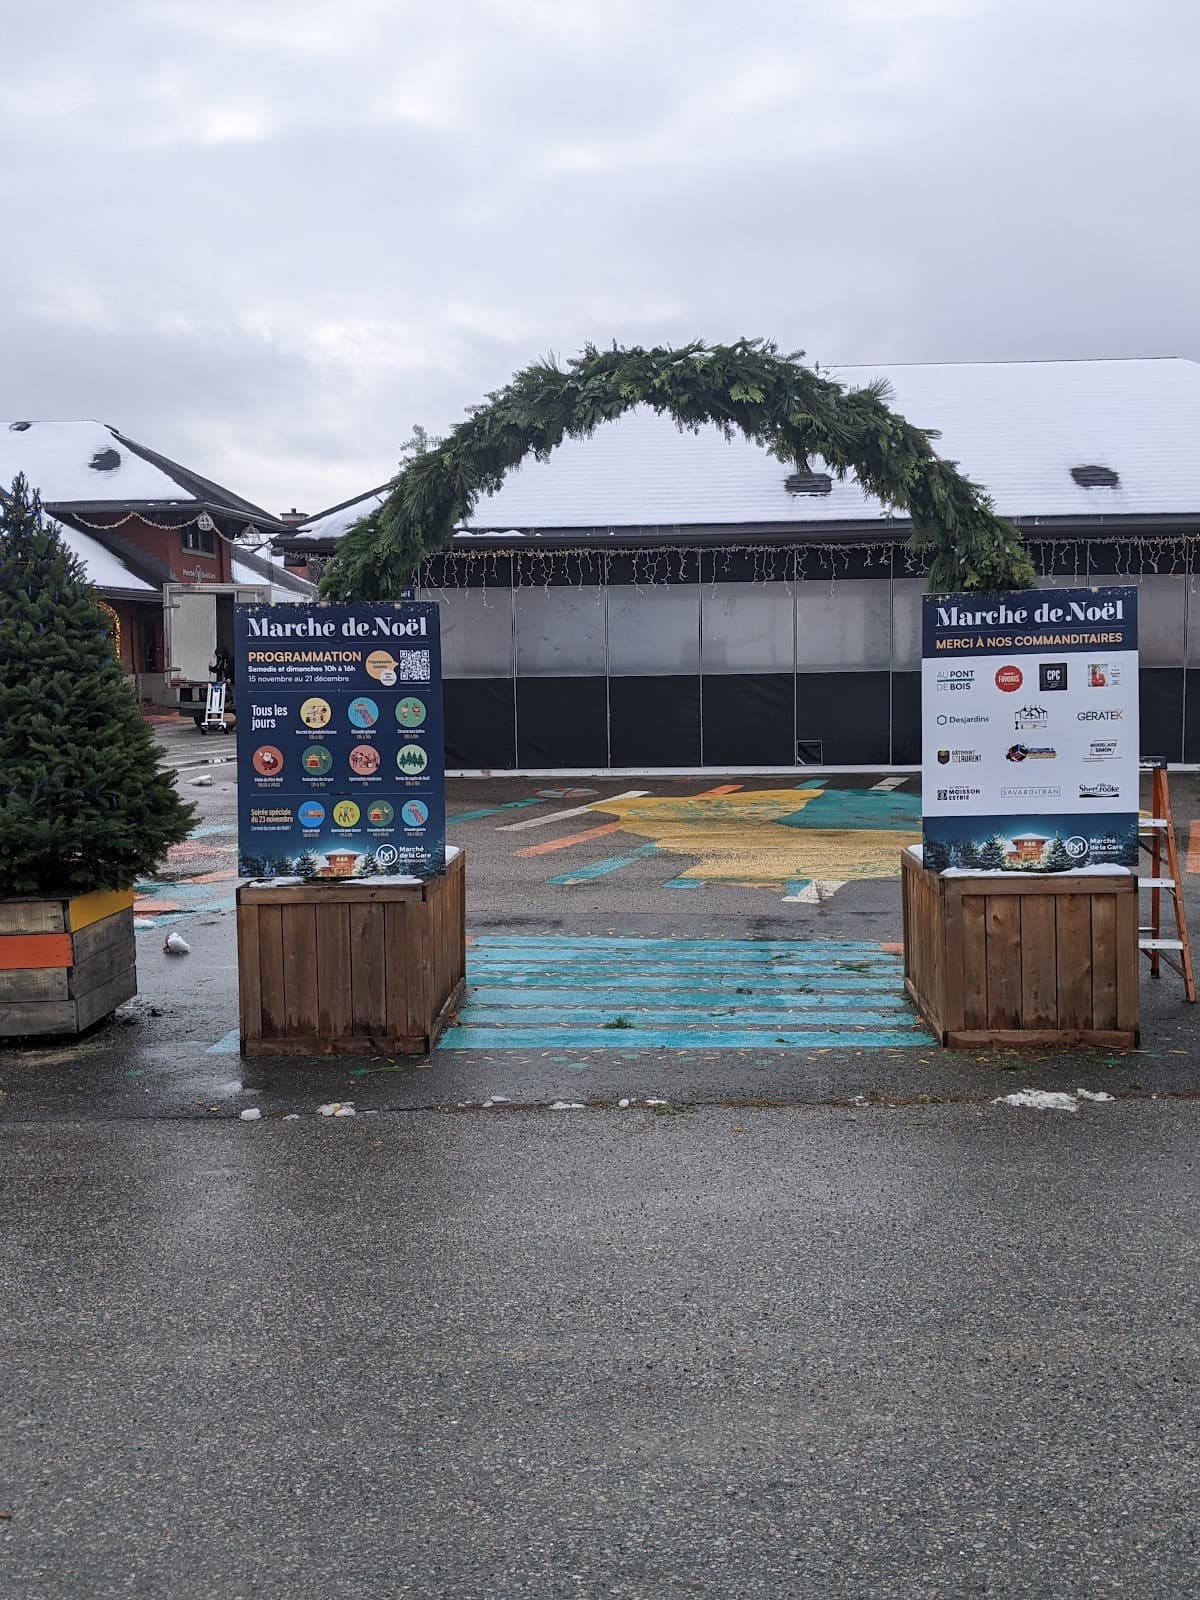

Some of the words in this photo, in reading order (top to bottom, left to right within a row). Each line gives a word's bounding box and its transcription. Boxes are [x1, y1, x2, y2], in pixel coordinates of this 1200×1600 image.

[934, 605, 1028, 626] Marché
[1034, 603, 1063, 623] de
[1065, 600, 1125, 622] Noël
[247, 617, 335, 637] Marché
[341, 617, 370, 636] de
[371, 616, 428, 636] Noël
[936, 638, 973, 650] MERCI
[976, 635, 984, 648] À
[987, 636, 1012, 647] NOS
[1014, 632, 1123, 646] COMMANDITAIRES
[248, 651, 361, 663] PROGRAMMATION
[950, 670, 974, 678] PONT
[1047, 669, 1060, 680] CPC
[950, 682, 971, 690] BOIS
[252, 704, 273, 716] Tous
[274, 704, 288, 716] les
[251, 717, 276, 731] jours
[949, 715, 989, 724] Desjardins
